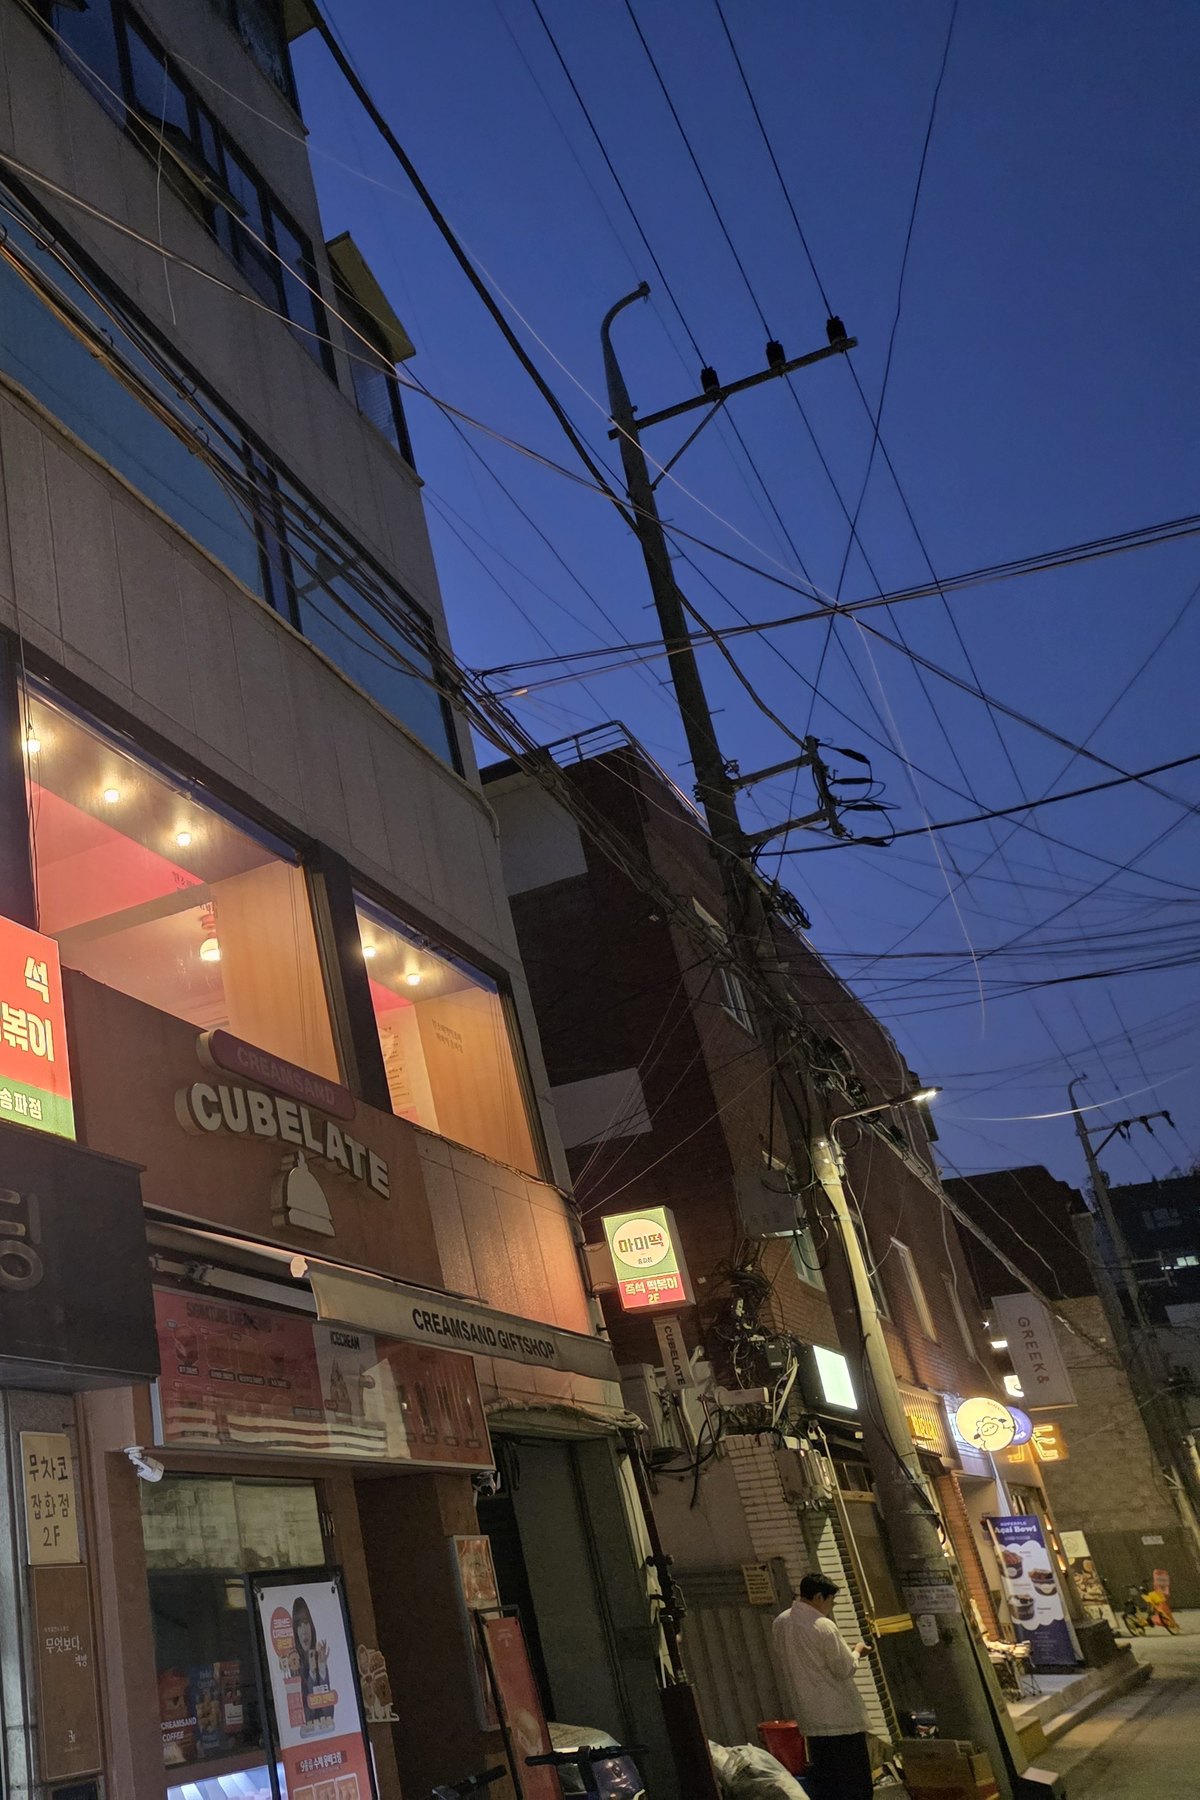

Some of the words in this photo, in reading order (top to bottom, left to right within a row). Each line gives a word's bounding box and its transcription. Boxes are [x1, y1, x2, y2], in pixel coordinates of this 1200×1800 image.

[237, 1046, 336, 1105] CREAMSAND
[190, 1081, 391, 1200] CUBELATE
[618, 1232, 664, 1253] 마미떡
[625, 1281, 645, 1296] 즉석
[646, 1277, 678, 1292] 떡볶이
[648, 1293, 660, 1304] 2F
[412, 1308, 497, 1346] CREAMSAND
[498, 1329, 555, 1361] GIFTSHOP
[664, 1325, 686, 1386] CUBELATE
[28, 1452, 68, 1484] 무차코
[32, 1491, 71, 1521] 잡화점
[42, 1525, 61, 1549] 2F
[1014, 1525, 1037, 1533] Bowl
[161, 1717, 197, 1730] CREAMSAND
[162, 1731, 185, 1742] COFFEE
